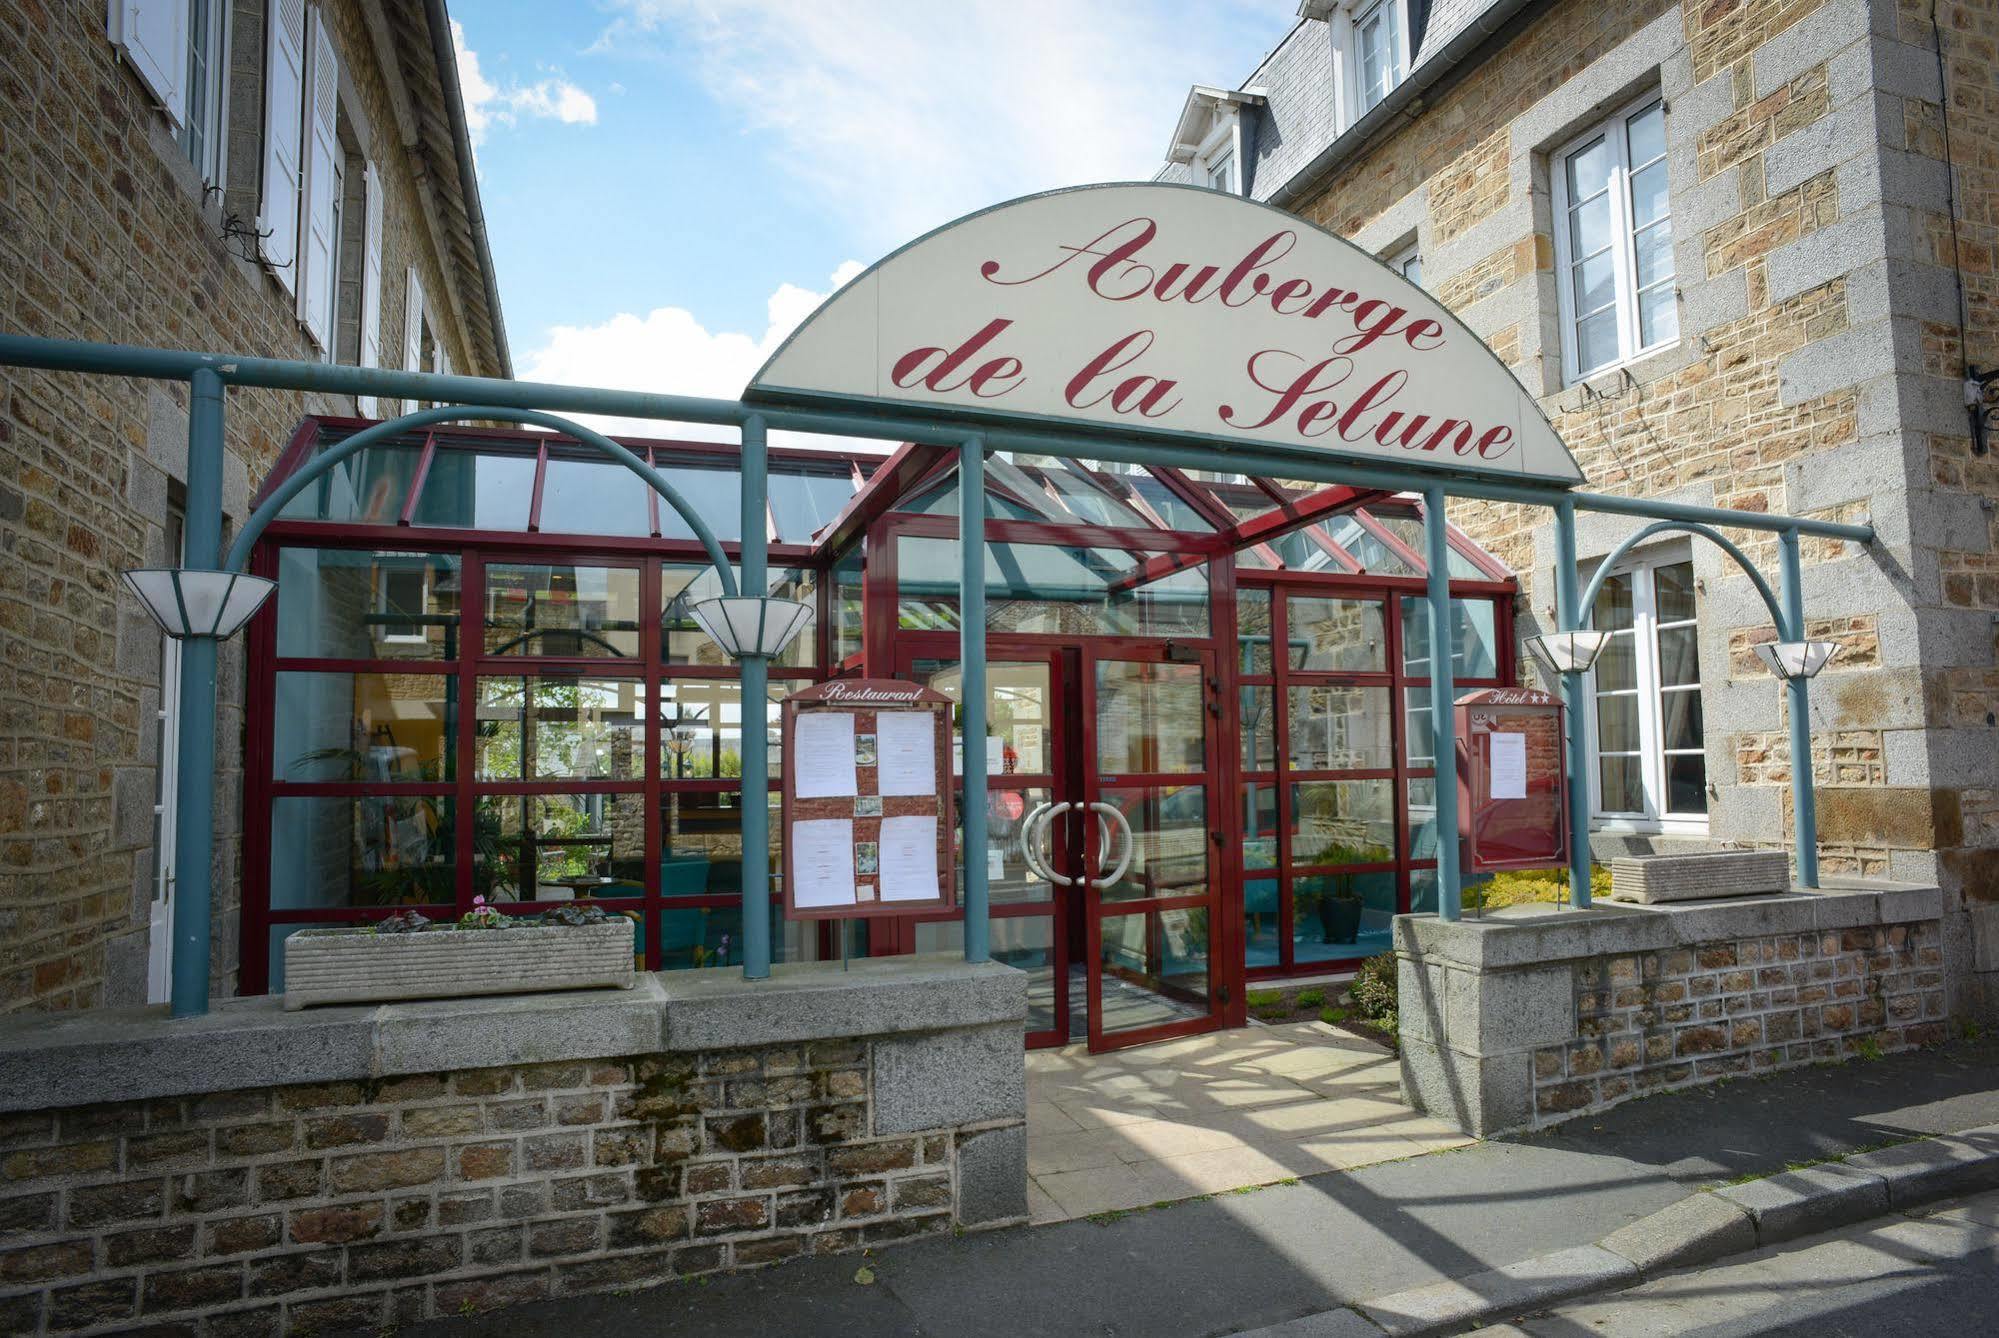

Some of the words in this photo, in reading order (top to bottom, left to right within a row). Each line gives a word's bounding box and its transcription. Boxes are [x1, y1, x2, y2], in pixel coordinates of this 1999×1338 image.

[981, 216, 1446, 356] Auberge
[891, 319, 1026, 399] de
[1063, 330, 1183, 419] la
[1218, 350, 1515, 461] Selune
[819, 682, 924, 701] Restaurant
[1489, 688, 1528, 704] Hôtel
